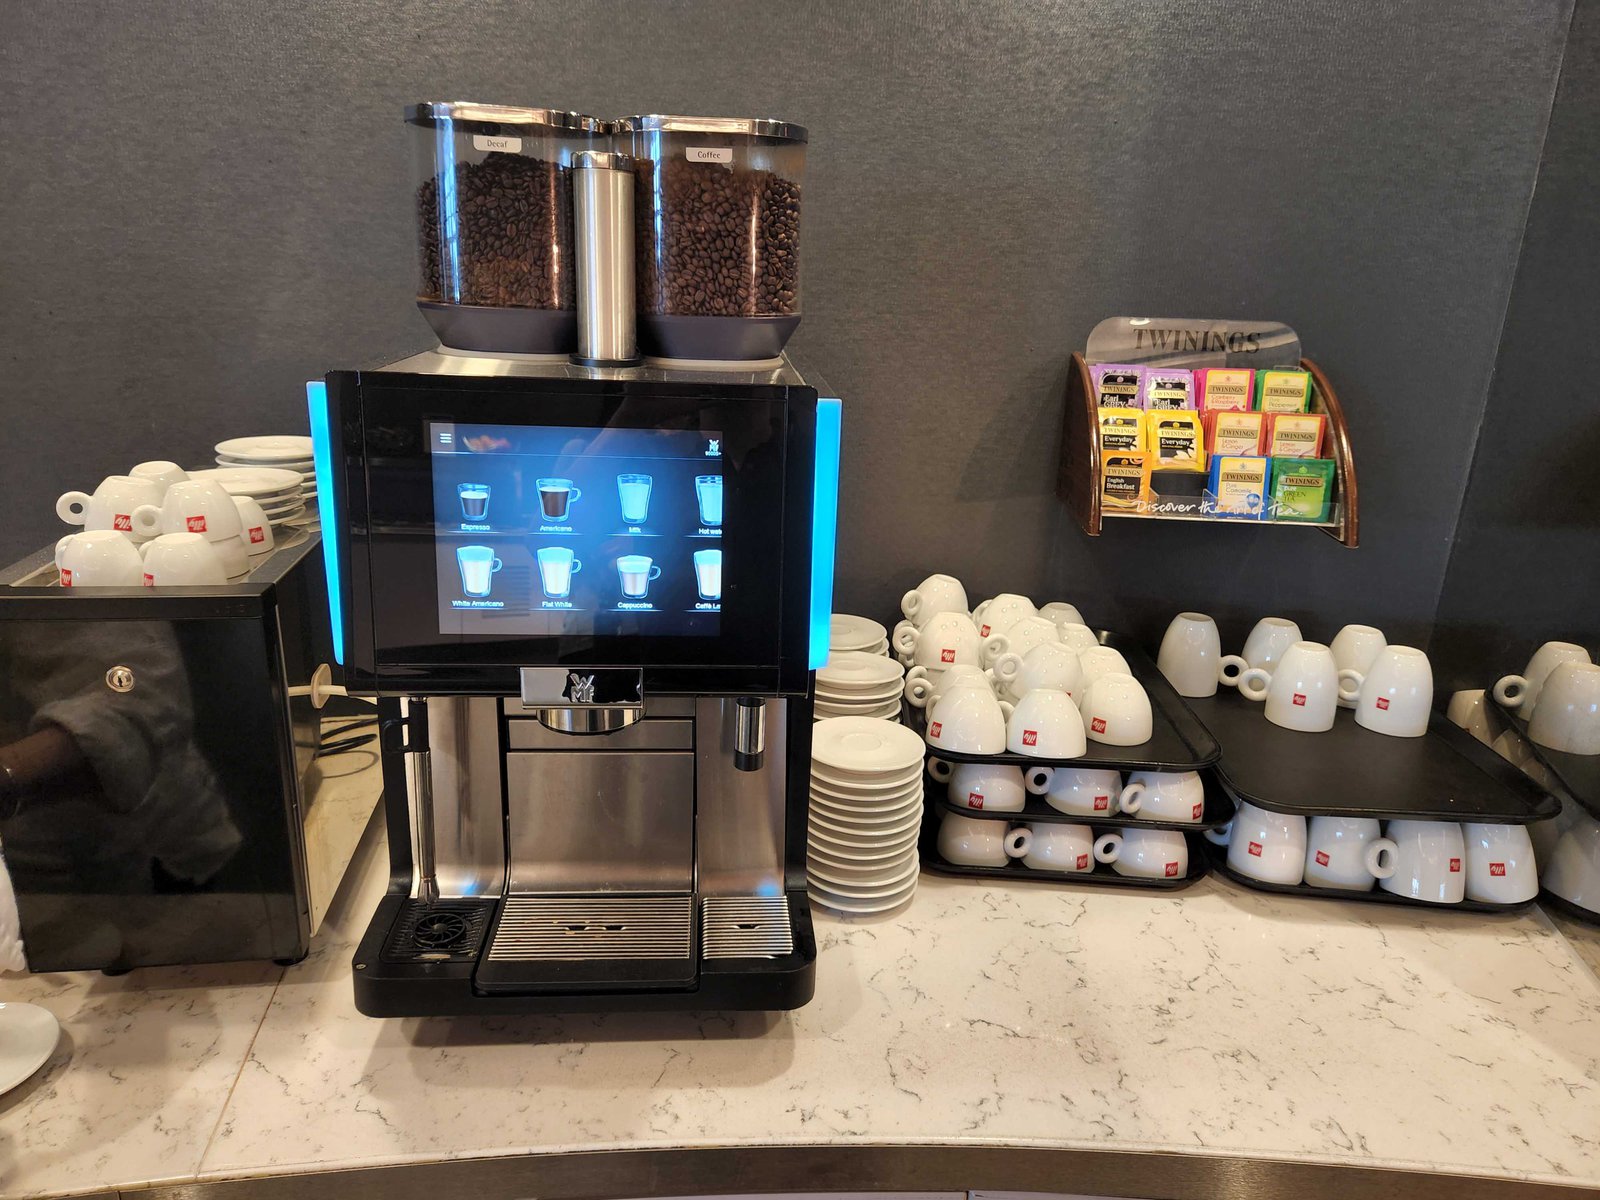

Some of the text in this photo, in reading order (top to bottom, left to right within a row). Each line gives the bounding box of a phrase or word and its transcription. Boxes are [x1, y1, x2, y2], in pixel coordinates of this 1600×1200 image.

[486, 139, 508, 149] Decaf
[697, 150, 722, 160] Coffee
[1133, 328, 1261, 354] TWININGS
[1103, 385, 1136, 393] TWININGS
[1211, 385, 1244, 393] TWININGS
[1103, 394, 1119, 402] Earl
[1153, 390, 1186, 398] TWININGS
[1222, 429, 1255, 437] TWININGS
[1279, 432, 1313, 440] TWININGS
[1104, 436, 1134, 444] Everyday
[1226, 473, 1260, 481] TWININGS
[1284, 477, 1320, 485] TWININGS
[1136, 500, 1196, 513] Discover
[1198, 500, 1221, 514] the
[460, 523, 491, 531] Espresso
[570, 673, 595, 703] WMF
